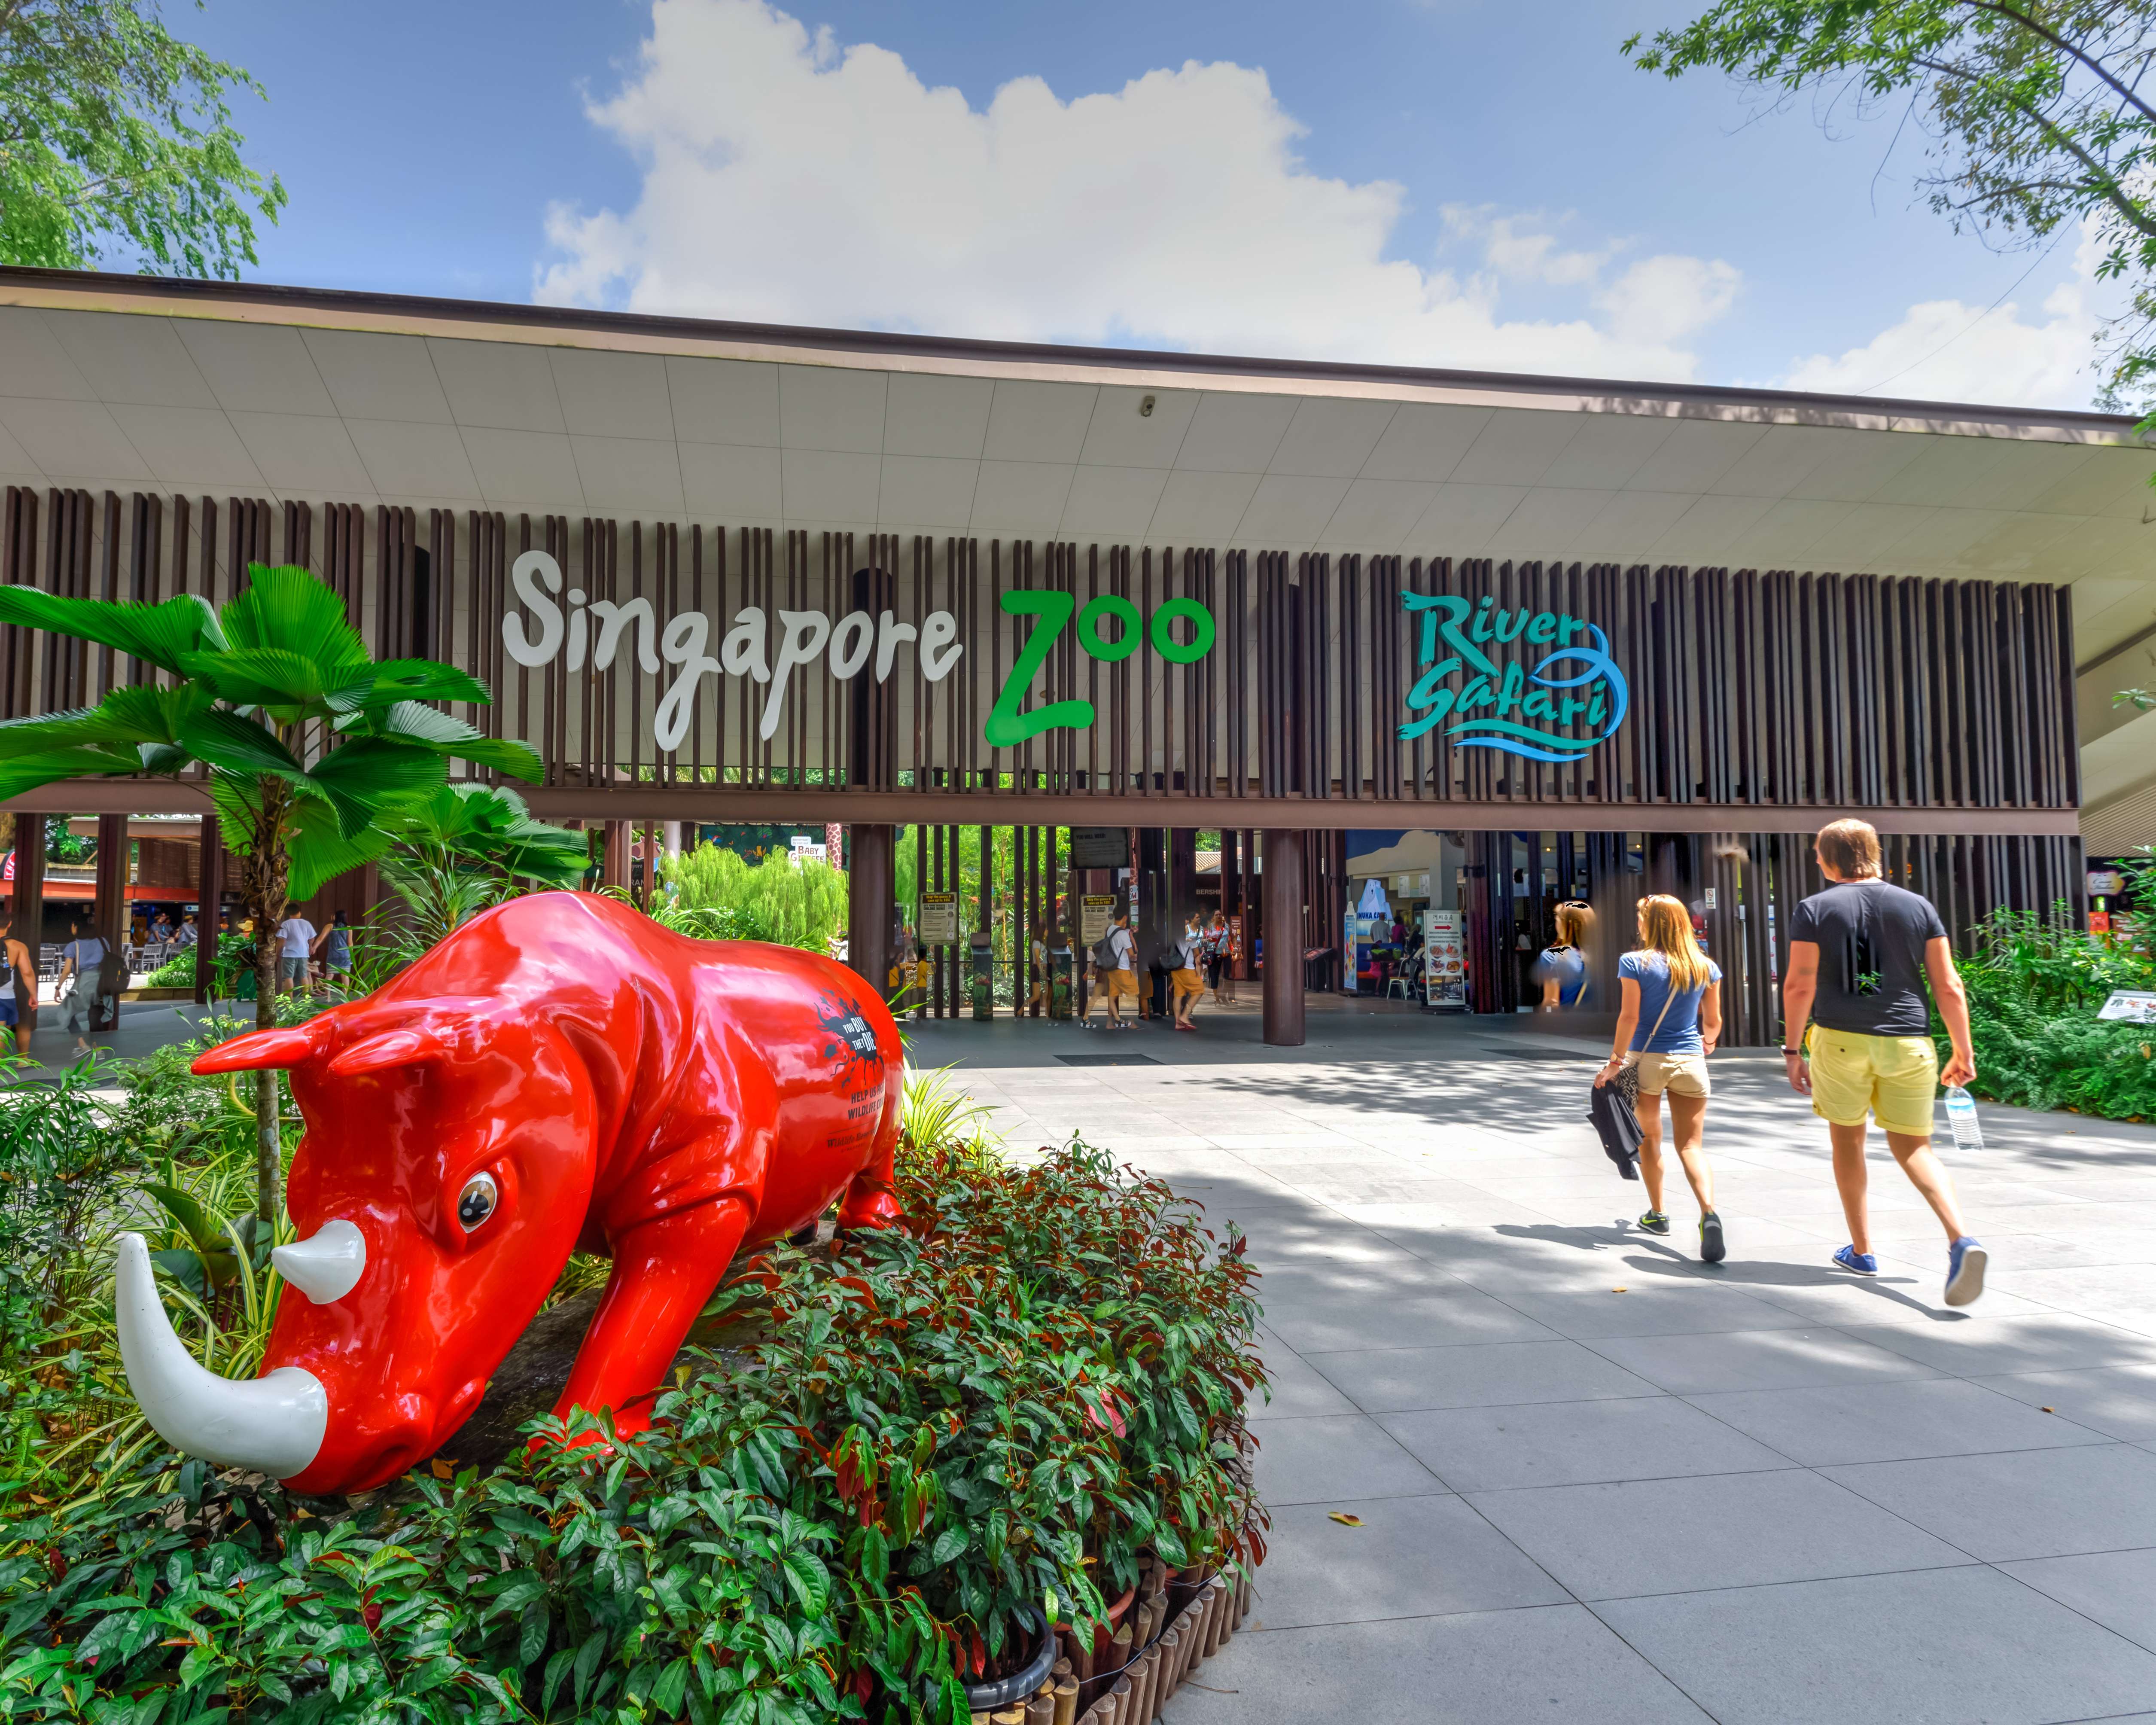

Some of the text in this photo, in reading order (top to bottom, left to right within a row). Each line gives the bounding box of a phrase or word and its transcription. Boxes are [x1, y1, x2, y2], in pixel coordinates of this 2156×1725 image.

[1398, 590, 1585, 678] River
[502, 550, 1215, 752] Singapore Zoo
[1397, 657, 1607, 741] Safari
[791, 853, 824, 863] GIFFE
[798, 846, 819, 855] BABY
[842, 1017, 867, 1034] YOU BUY
[852, 1031, 877, 1051] THEY DIE
[851, 1089, 868, 1104] HELP
[870, 1086, 876, 1098] US
[848, 1101, 876, 1120] WILDLIFE
